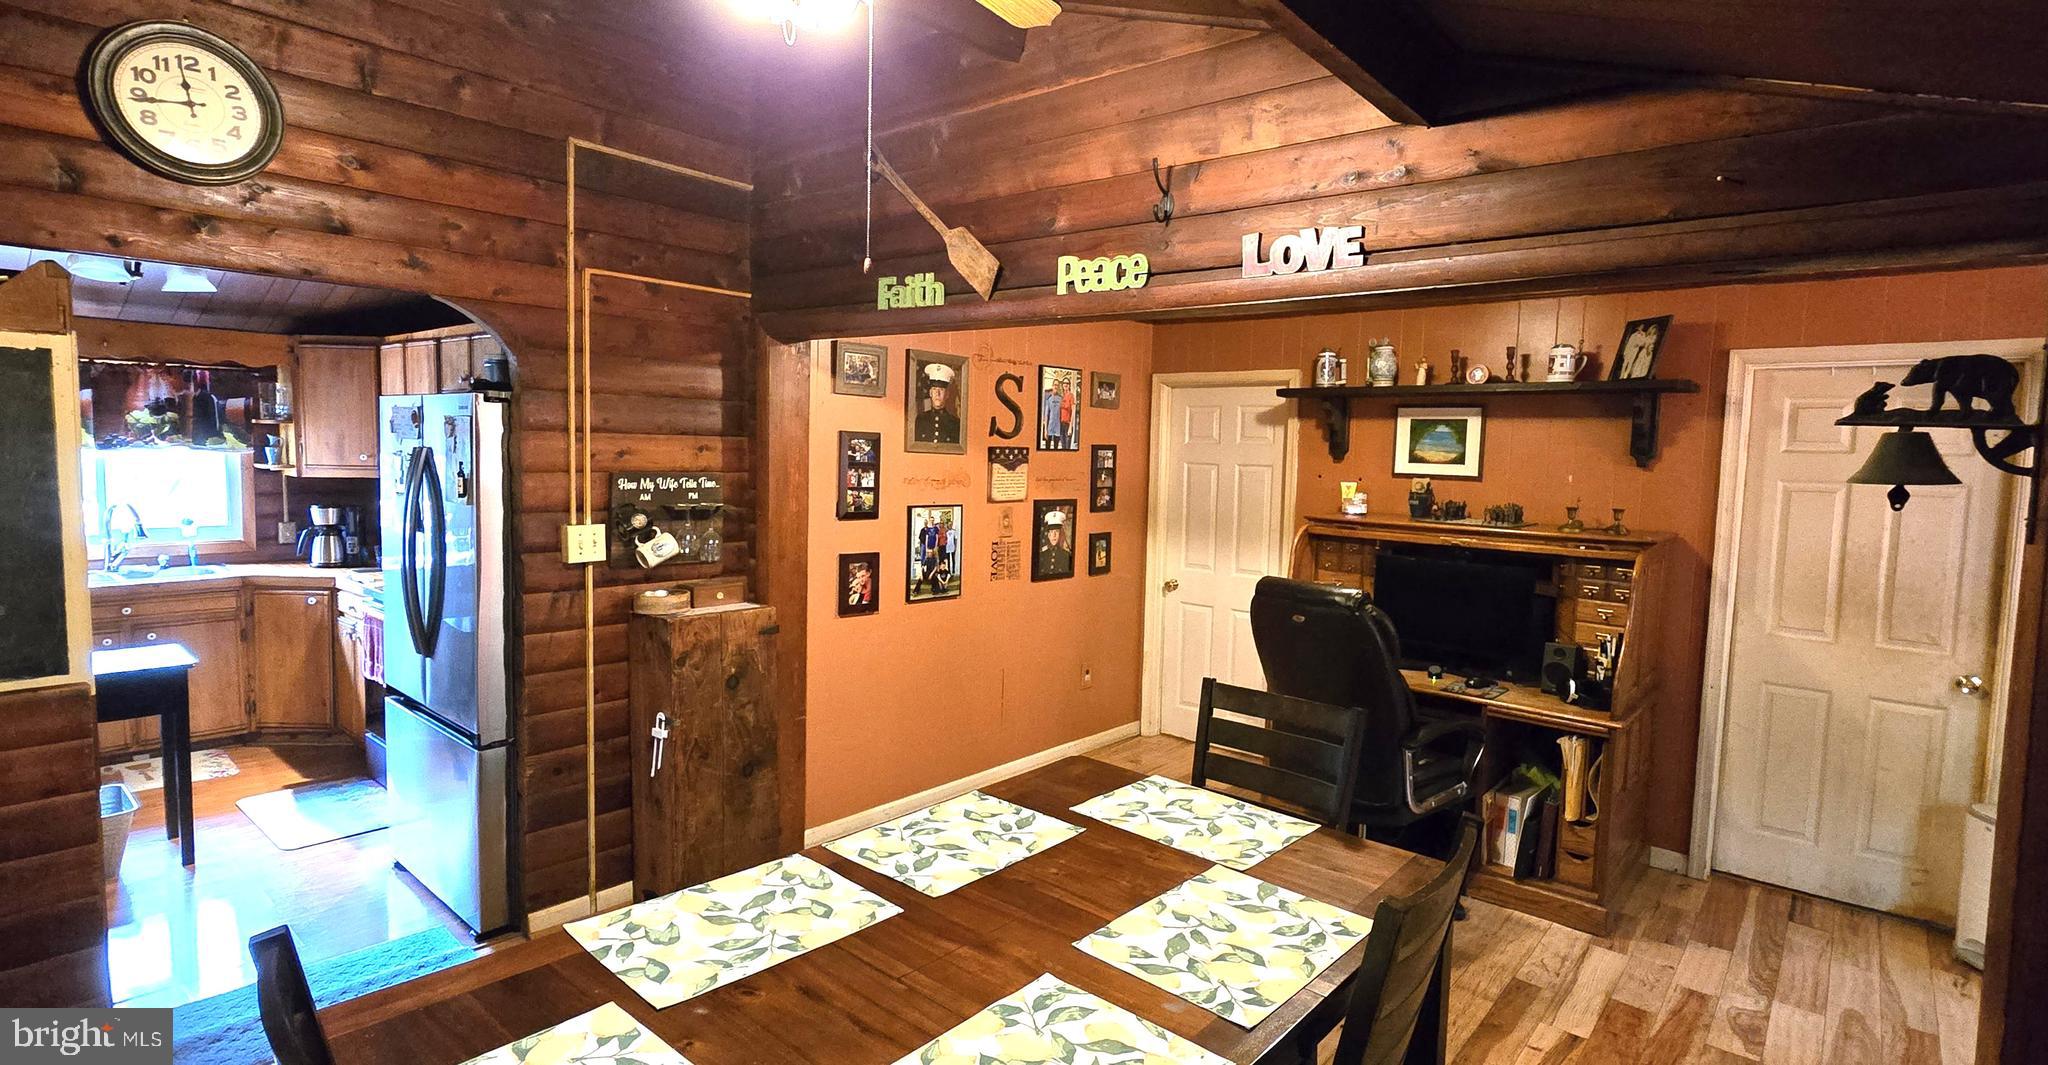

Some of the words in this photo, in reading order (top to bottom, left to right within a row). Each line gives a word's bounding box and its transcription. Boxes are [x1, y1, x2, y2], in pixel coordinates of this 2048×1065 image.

[152, 55, 170, 72] 11
[175, 54, 201, 73] 12
[130, 66, 157, 84] 10
[208, 66, 217, 81] 1
[130, 87, 148, 102] 9
[224, 85, 241, 100] 2
[139, 109, 158, 126] 8
[231, 106, 248, 121] 3
[226, 125, 242, 140] 4
[1241, 224, 1366, 279] LOVE
[1057, 253, 1149, 296] Peace
[877, 272, 945, 311] Faith
[988, 372, 1024, 440] S
[618, 479, 637, 490] How
[640, 478, 655, 491] My
[656, 477, 678, 492] Wife
[679, 477, 697, 489] Tells
[990, 540, 999, 582] LOVE
